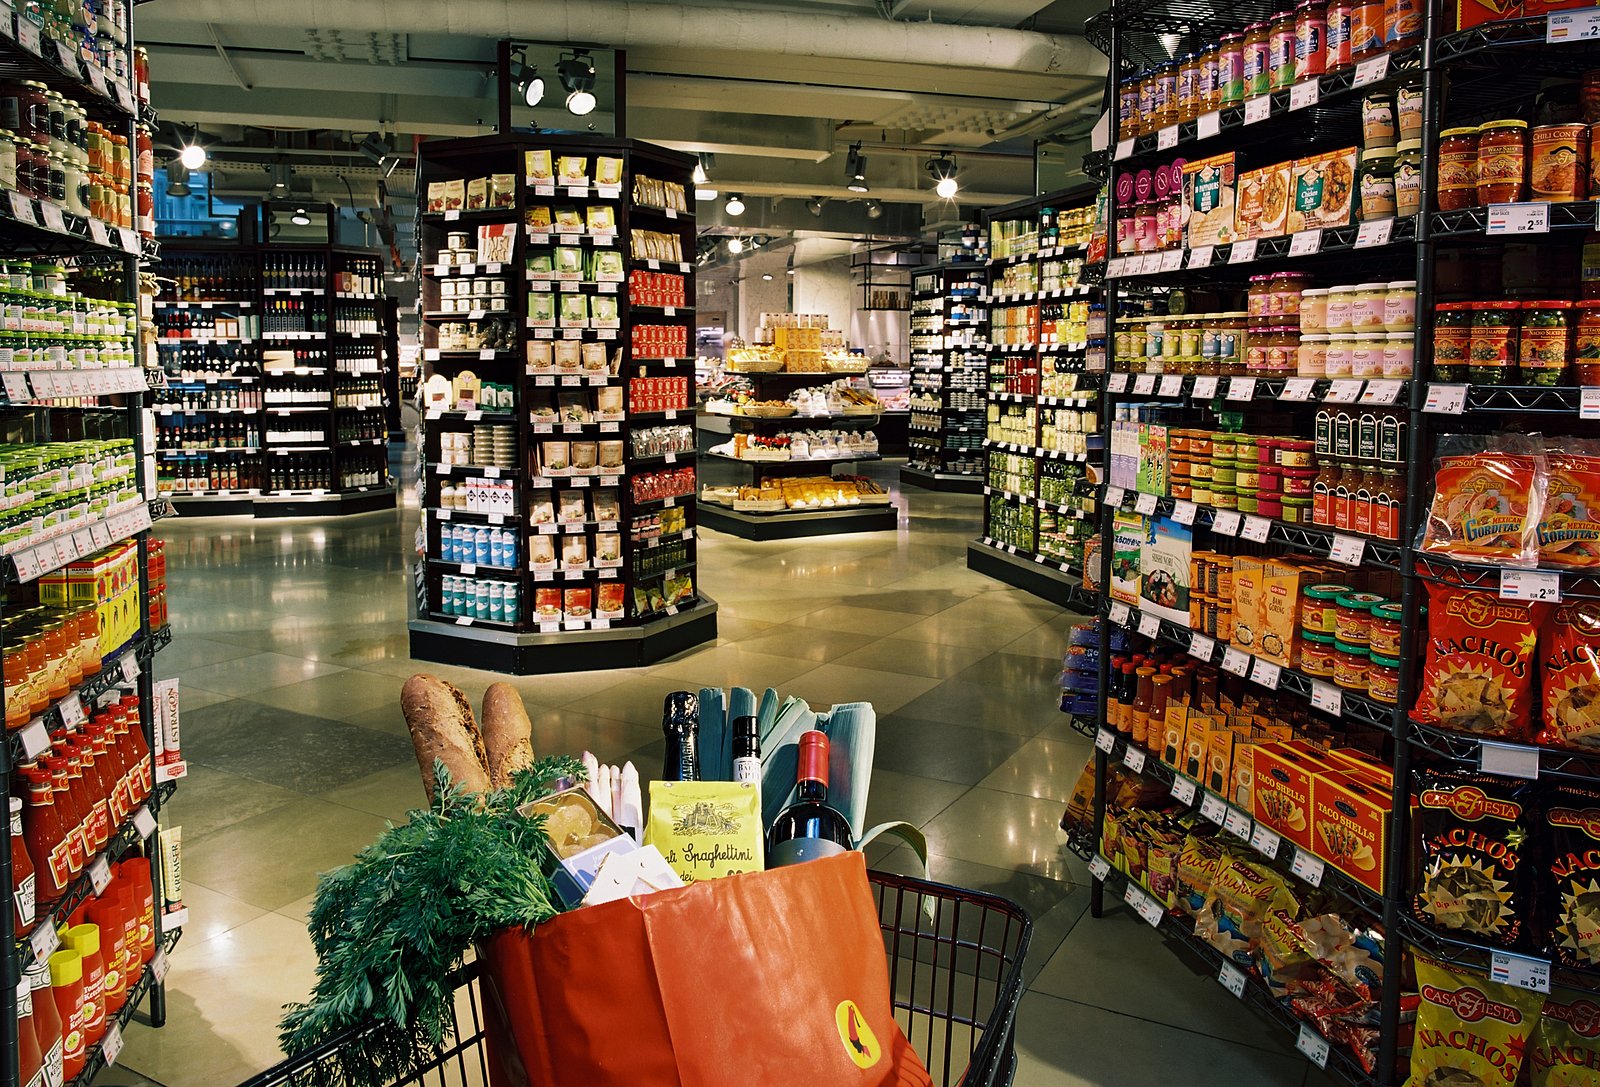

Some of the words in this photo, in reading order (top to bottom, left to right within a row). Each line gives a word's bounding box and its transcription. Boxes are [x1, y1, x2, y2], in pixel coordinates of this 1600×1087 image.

[1533, 132, 1552, 141] CHILI
[1527, 220, 1543, 230] 2.55
[1474, 479, 1503, 493] FIESTA
[1548, 479, 1580, 496] FIESTA
[1465, 519, 1520, 542] GORDITAS
[1537, 522, 1600, 546] GORDITAS
[1540, 588, 1555, 599] 2.90
[1468, 596, 1529, 623] FIESTA
[1435, 635, 1526, 679] NACHOS
[168, 688, 178, 742] ESTRAGON
[1566, 724, 1581, 732] Dip
[1257, 771, 1275, 787] TACO
[1276, 781, 1306, 804] SHELLS
[1423, 793, 1456, 806] CASA
[1455, 791, 1517, 818] FIESTA
[1317, 802, 1339, 821] TACO
[1340, 815, 1375, 842] SHELLS
[1550, 810, 1587, 824] CASA
[682, 843, 753, 869] Spaghettini
[1428, 828, 1520, 871] NACHOS
[172, 844, 181, 892] KREMSER
[680, 871, 694, 882] dei
[126, 928, 137, 939] Hot
[1578, 931, 1592, 940] Dip
[1530, 977, 1546, 988] 3.00
[1423, 988, 1458, 1007] CASA
[1457, 990, 1517, 1023] FIESTA
[1418, 1029, 1519, 1082] NACHOS
